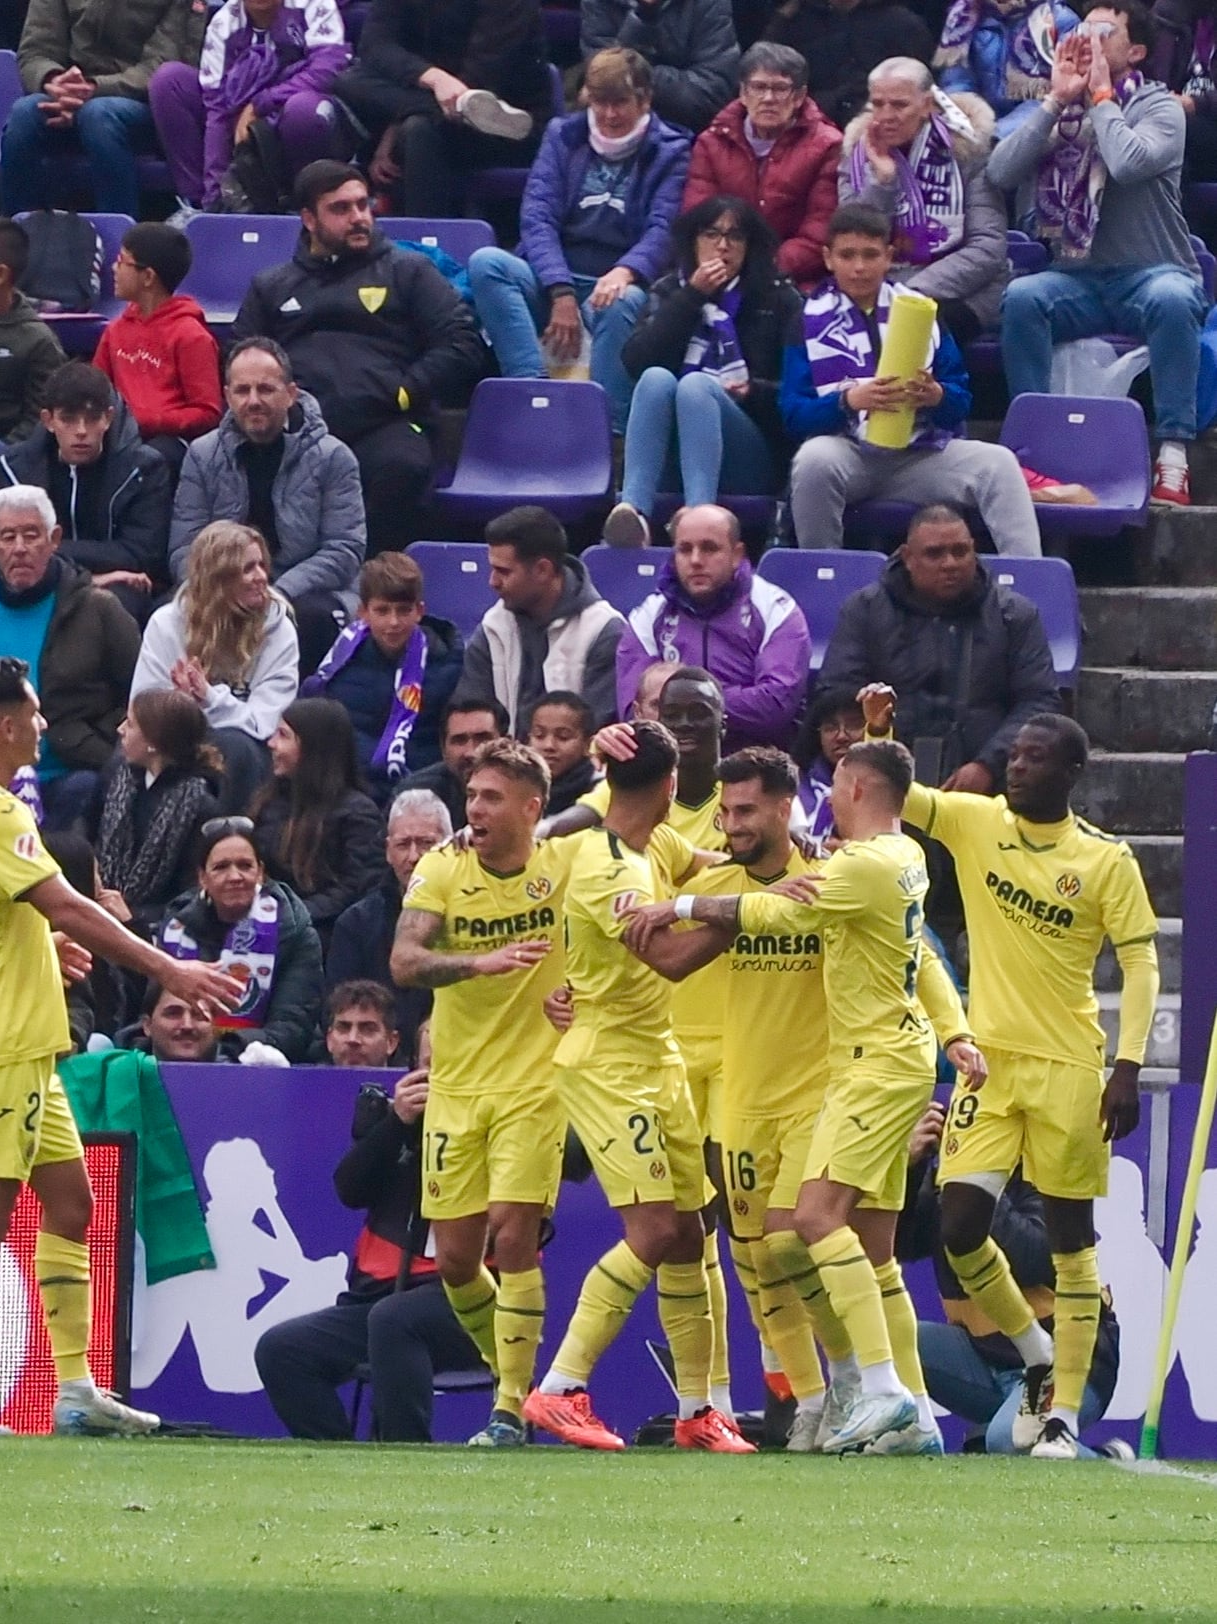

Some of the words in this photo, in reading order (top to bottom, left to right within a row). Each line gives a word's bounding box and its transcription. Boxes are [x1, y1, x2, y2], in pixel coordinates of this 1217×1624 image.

[985, 870, 1074, 929] PAMESA
[454, 906, 555, 937] PAMESA
[726, 934, 820, 955] AMESA
[426, 1132, 449, 1171] 17
[727, 1150, 756, 1191] 16
